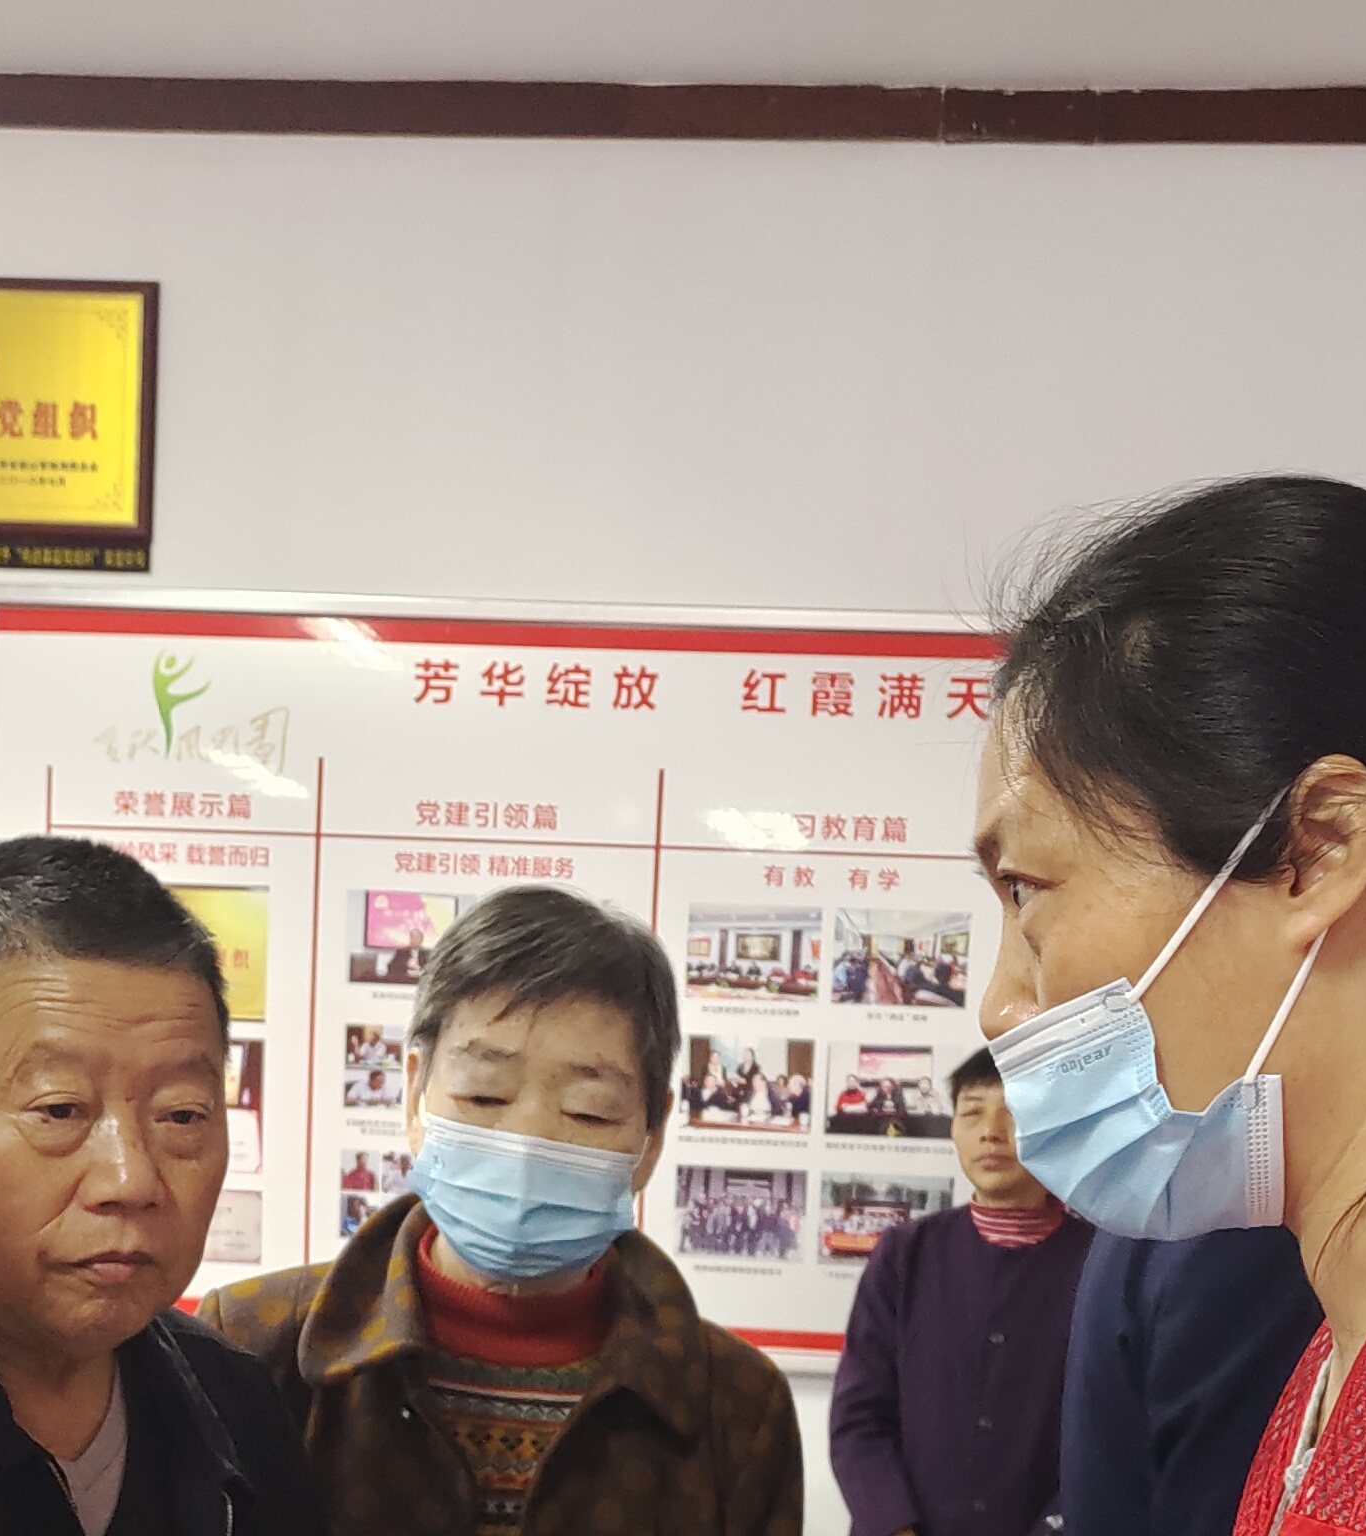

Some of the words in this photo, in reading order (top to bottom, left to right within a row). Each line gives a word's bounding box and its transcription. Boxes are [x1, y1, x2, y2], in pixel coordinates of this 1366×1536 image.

[413, 659, 660, 710] 芳华绽放
[741, 668, 992, 720] 红霞满天
[114, 790, 253, 820] 荣誉展示篇
[416, 799, 559, 832] 党建引领篇
[767, 812, 909, 843] 习教育篇
[186, 842, 270, 867] 载誉而归
[394, 850, 480, 876] 党建引领
[487, 854, 576, 881] 精准服务
[764, 864, 816, 888] 有教
[848, 867, 901, 891] 有学
